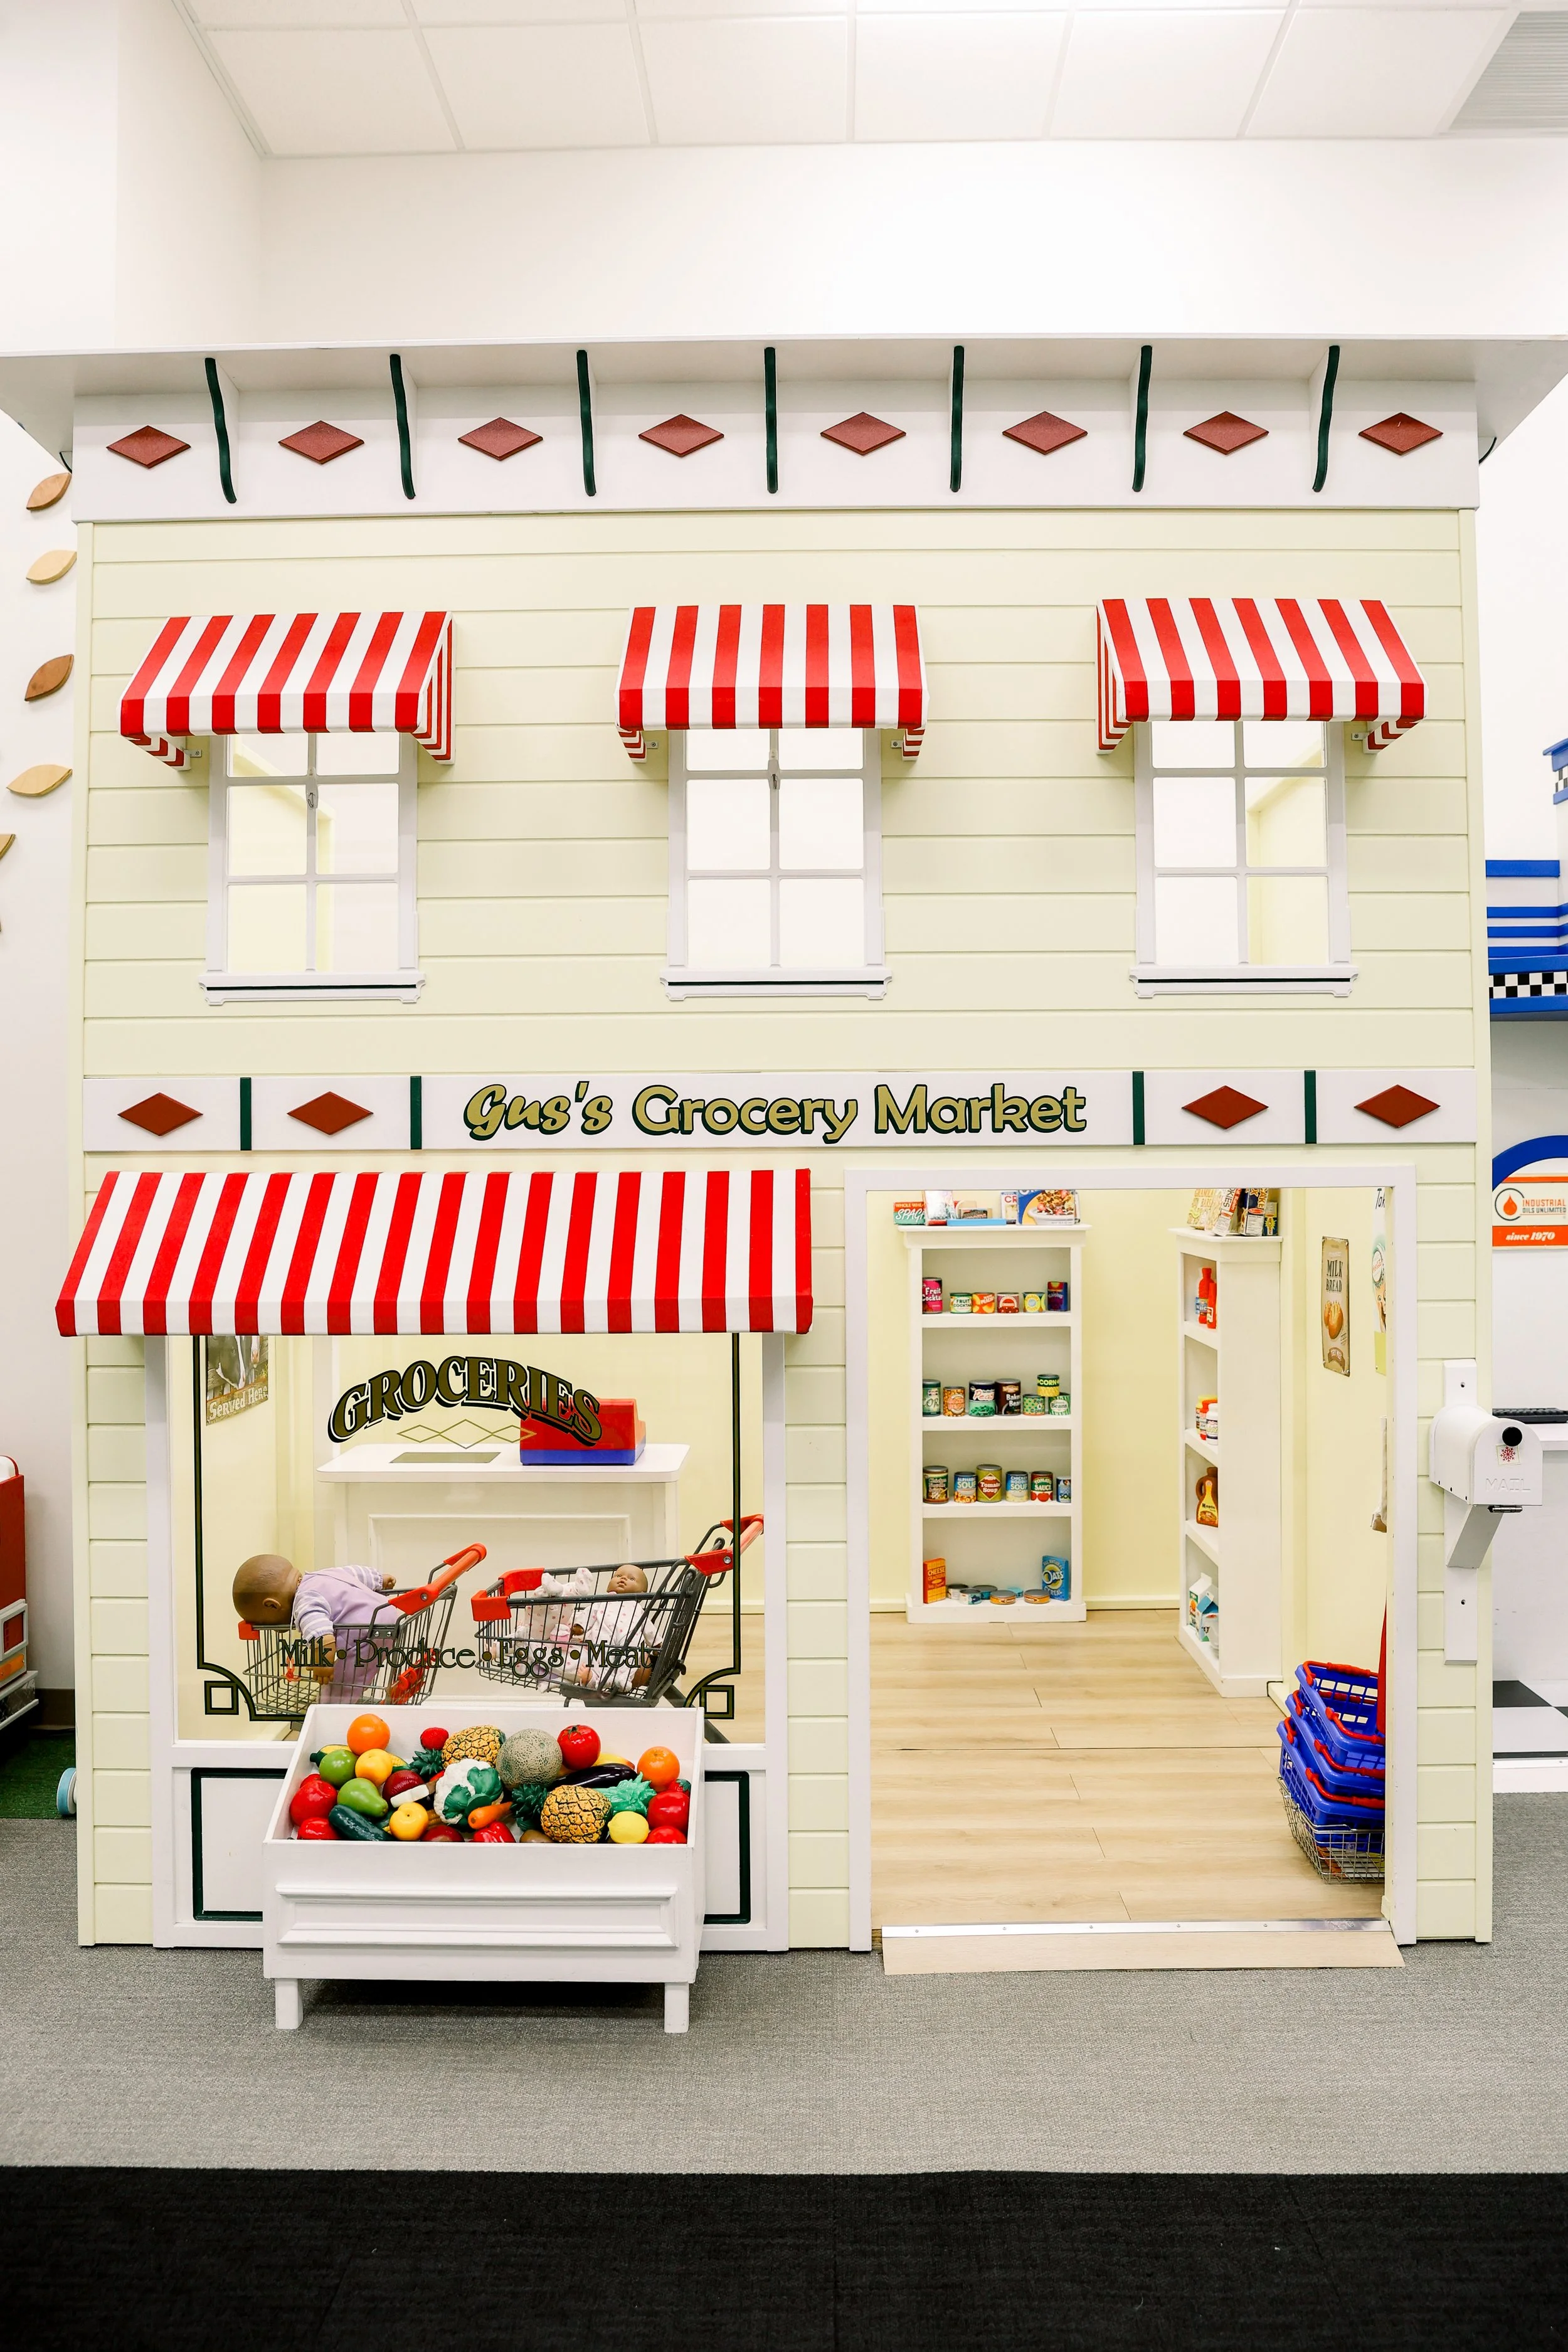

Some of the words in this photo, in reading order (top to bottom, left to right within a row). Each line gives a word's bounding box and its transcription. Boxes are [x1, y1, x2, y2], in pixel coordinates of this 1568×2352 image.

[464, 1081, 613, 1141] Gus's
[632, 1084, 858, 1144] Grocery
[874, 1083, 1087, 1134] Market
[1506, 1232, 1529, 1241] since
[1530, 1232, 1555, 1241] 1970
[1327, 1259, 1343, 1278] MILK
[1326, 1278, 1342, 1292] BREAD
[327, 1355, 603, 1447] GROCERIES
[973, 1389, 993, 1401] Peas
[209, 1391, 246, 1421] Served
[248, 1385, 268, 1405] Here
[1485, 1478, 1531, 1490] MAIL
[928, 1567, 945, 1576] CHEESE
[1042, 1570, 1064, 1584] OATS
[279, 1636, 333, 1667] Milk
[354, 1637, 476, 1668] Produce
[497, 1638, 564, 1678] Eggs
[585, 1640, 652, 1668] Meat
